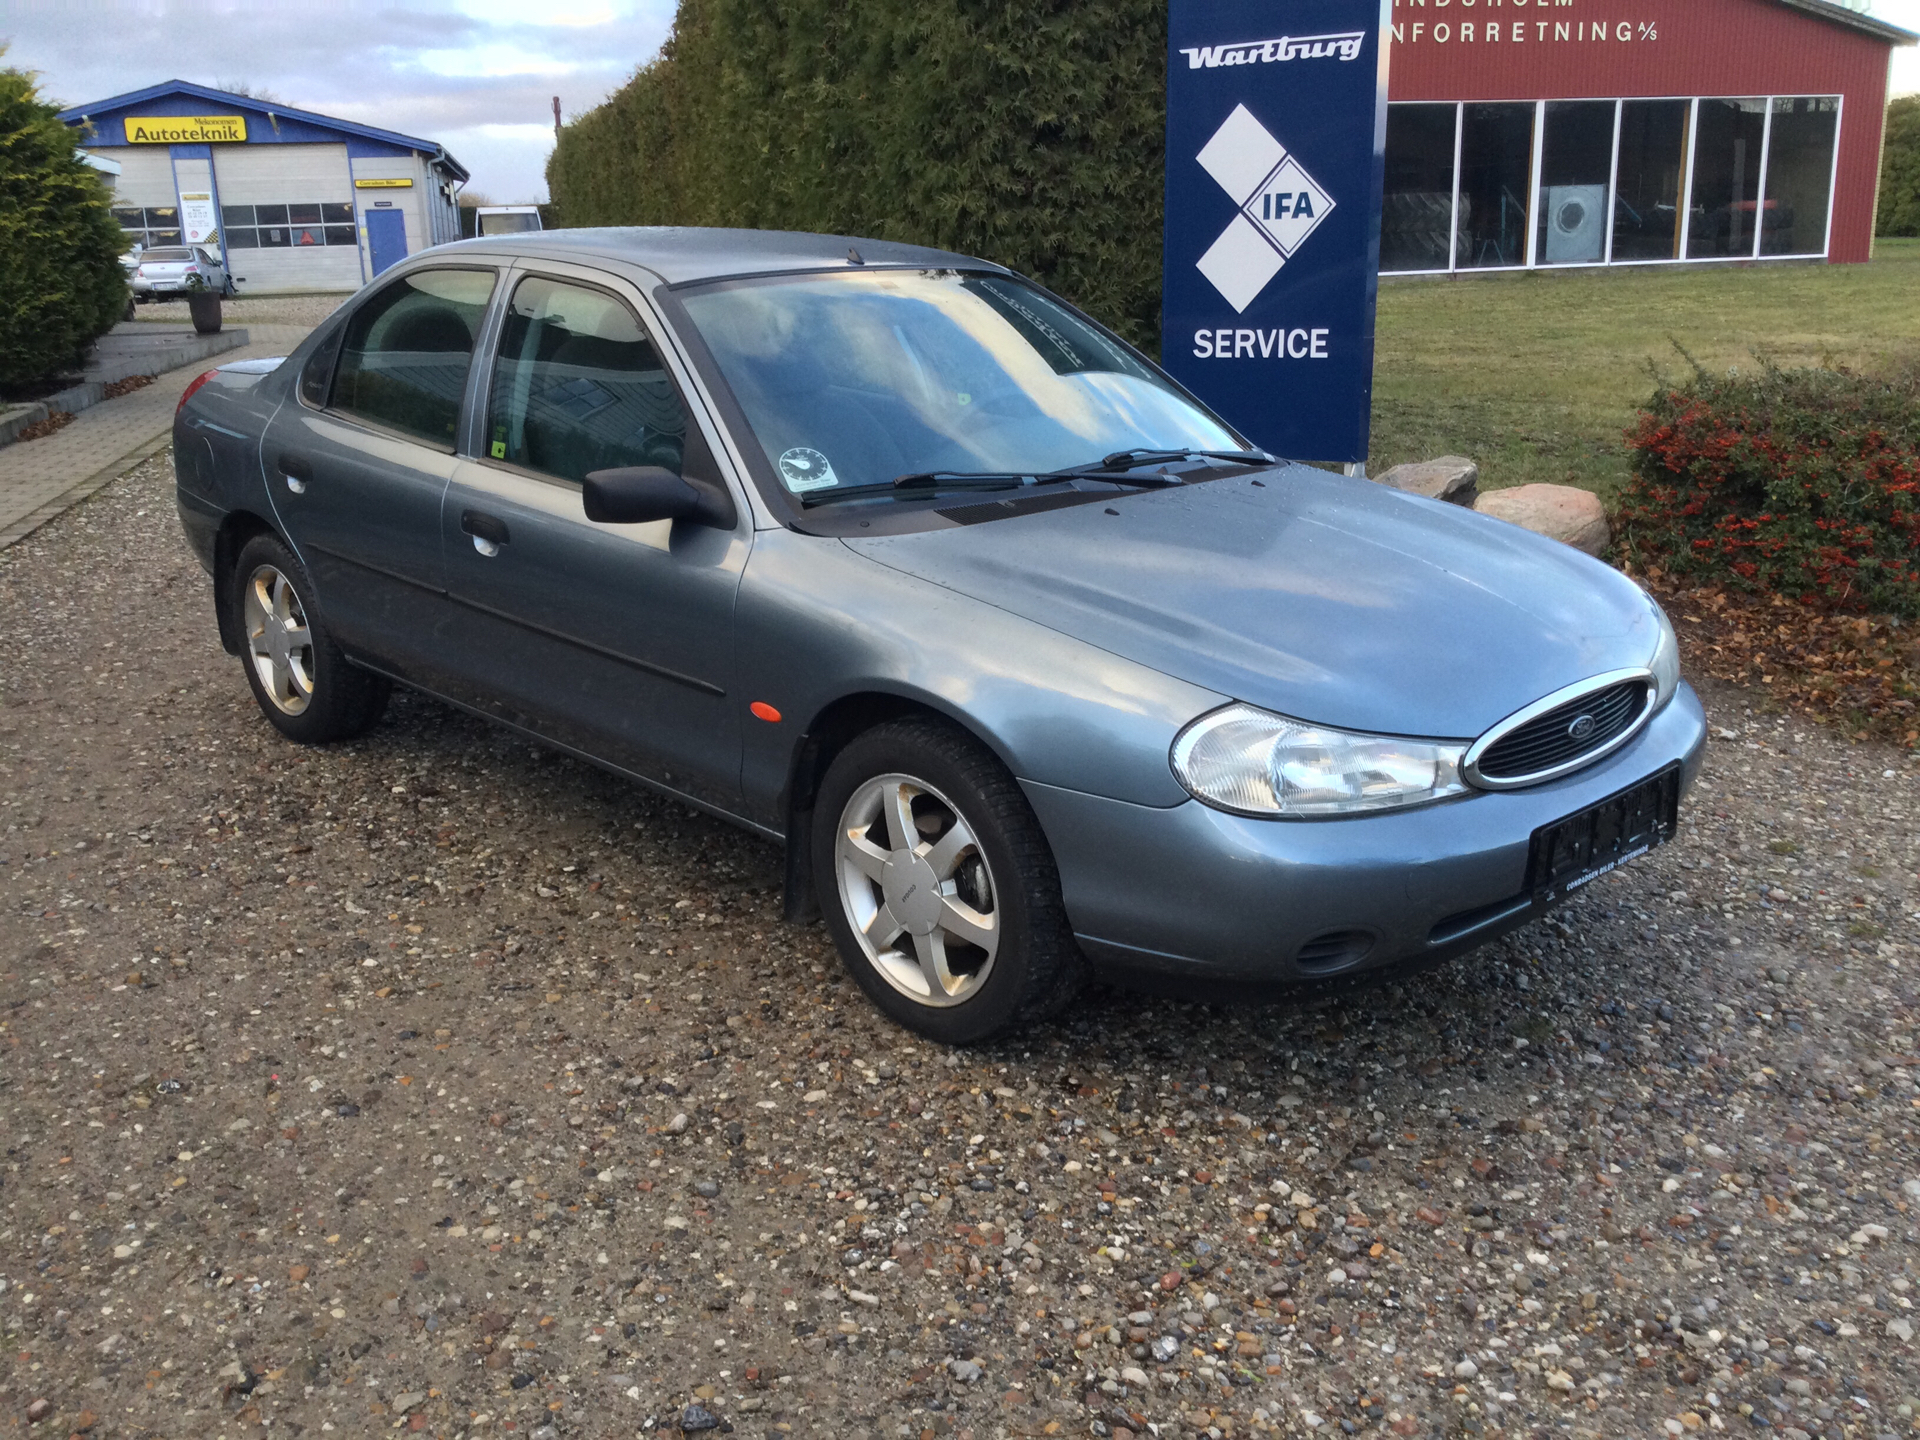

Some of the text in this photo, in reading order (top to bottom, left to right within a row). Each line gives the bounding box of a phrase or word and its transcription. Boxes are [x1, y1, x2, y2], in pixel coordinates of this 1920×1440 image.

[1178, 31, 1366, 69] Wartburg
[134, 126, 239, 141] Autoteknik
[194, 118, 237, 126] Mekonomen
[1262, 191, 1315, 220] IFA
[1192, 328, 1330, 359] SERVICE
